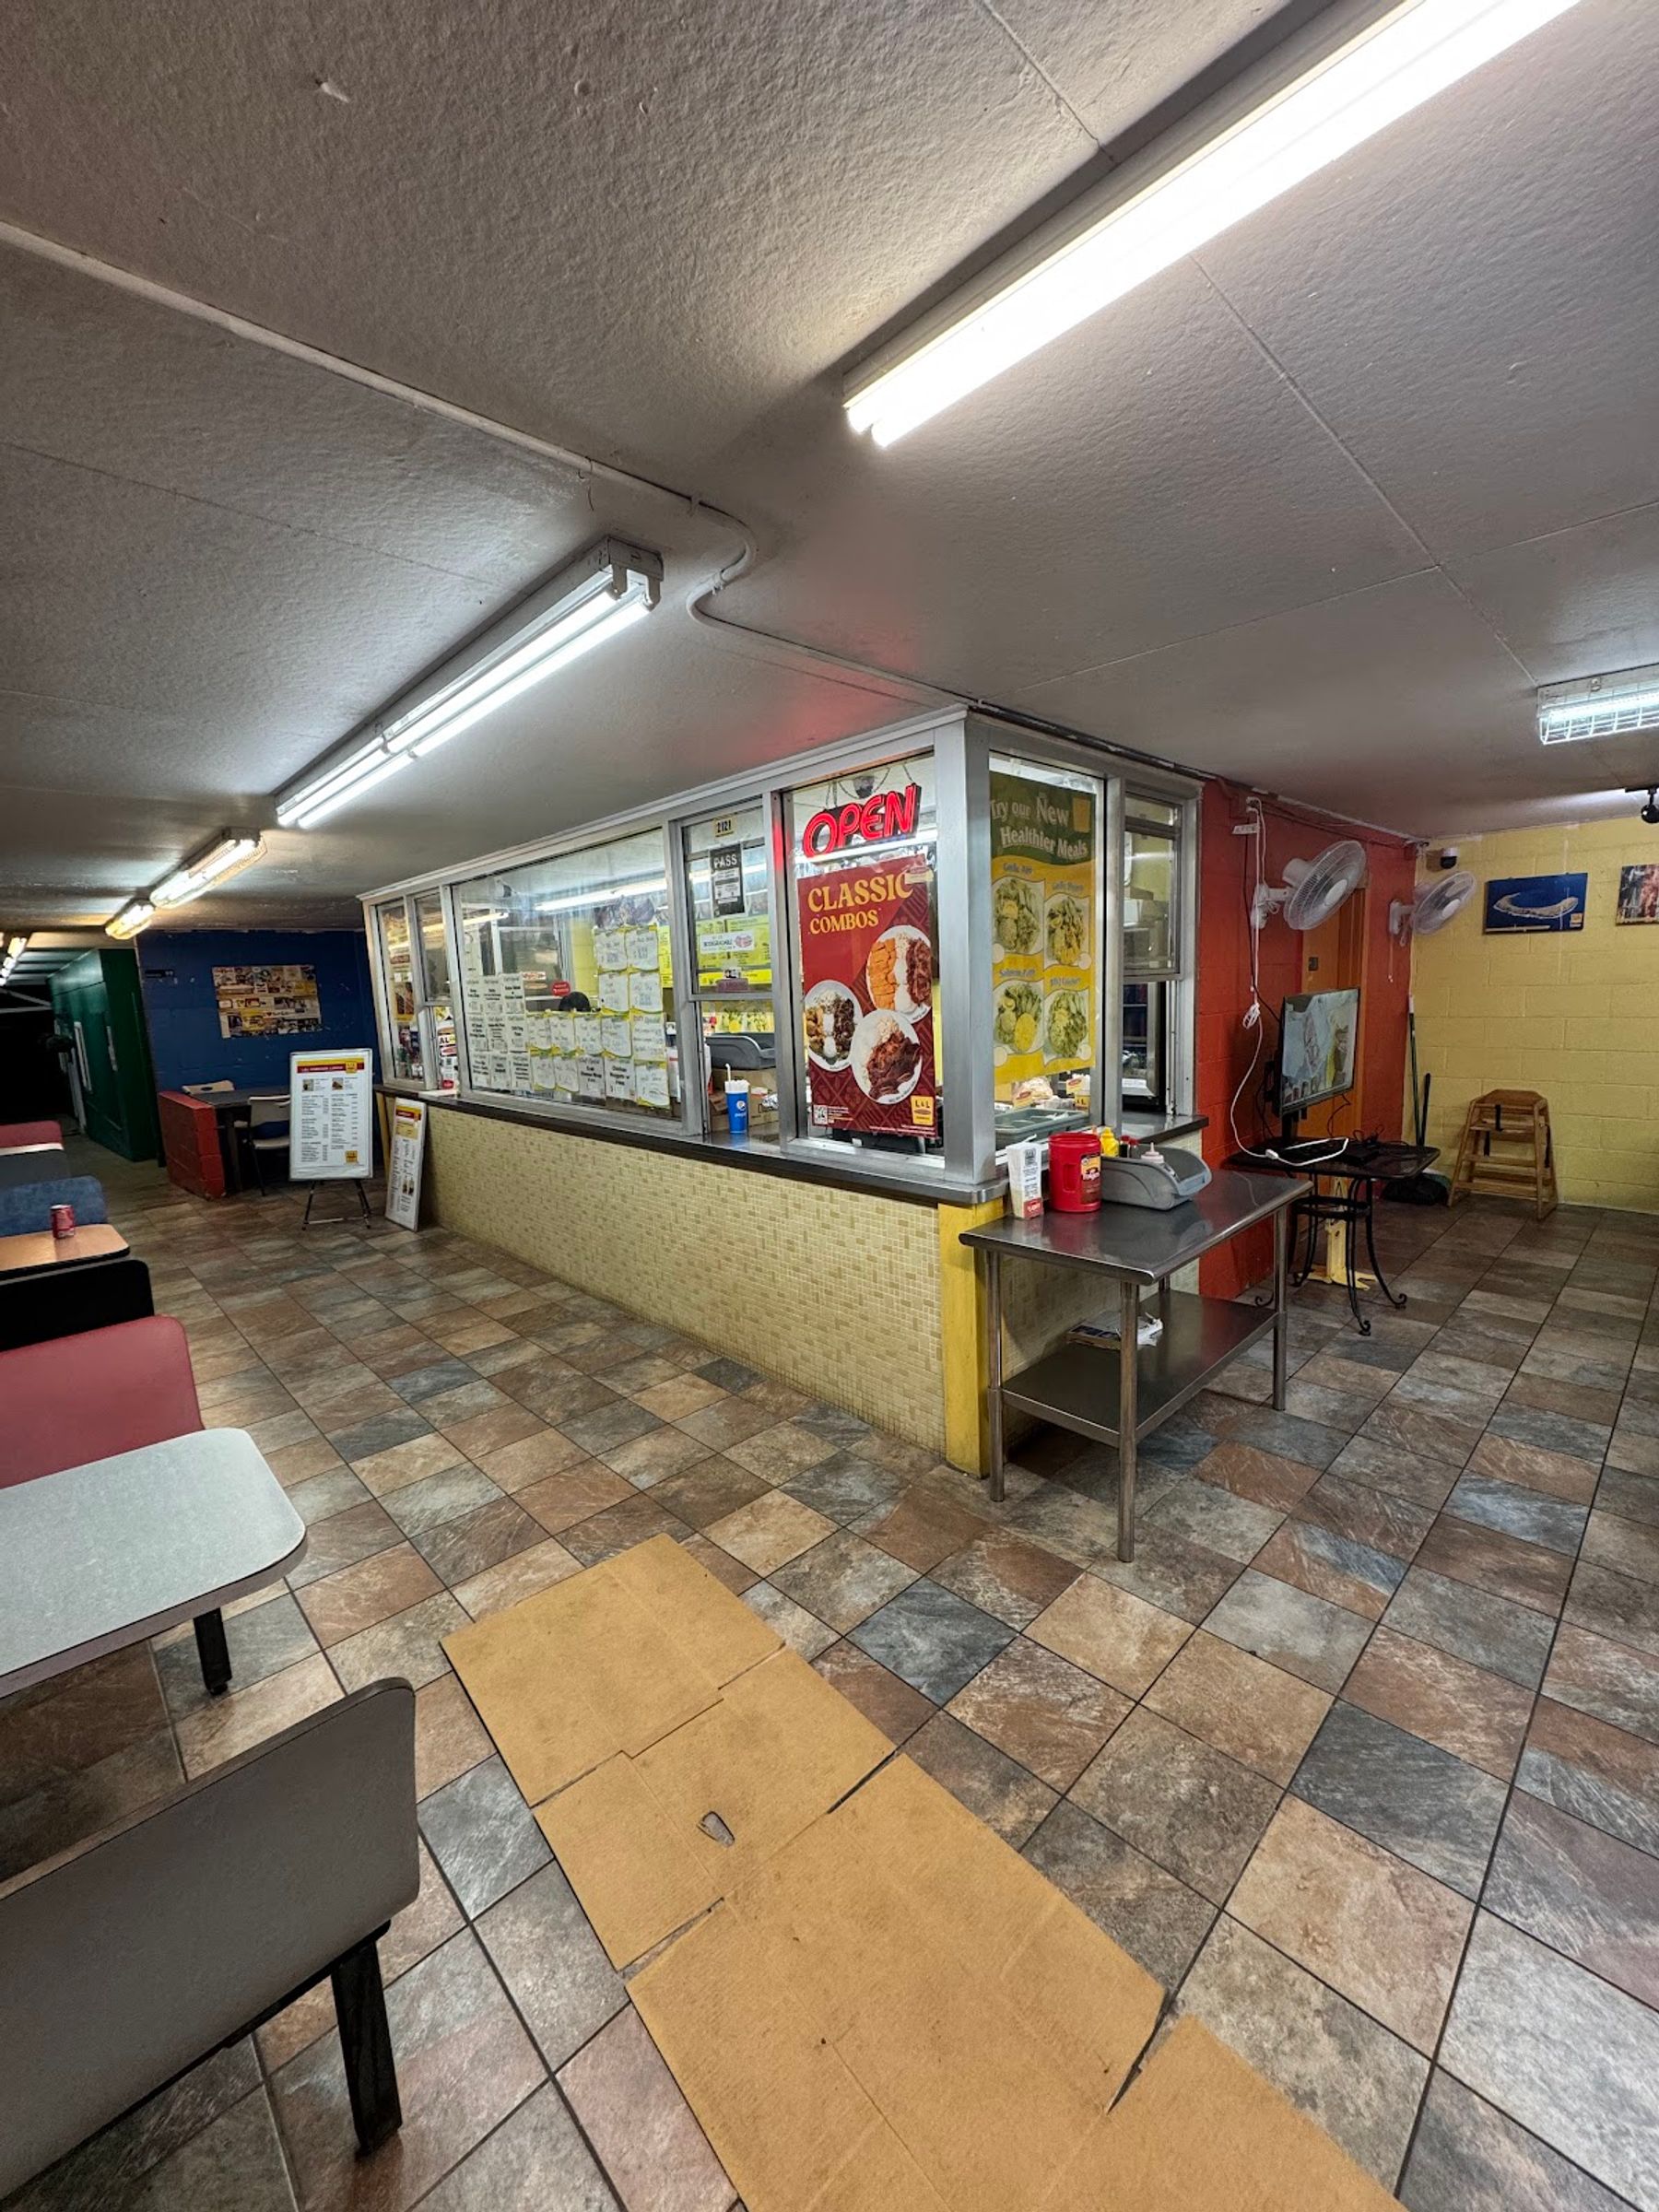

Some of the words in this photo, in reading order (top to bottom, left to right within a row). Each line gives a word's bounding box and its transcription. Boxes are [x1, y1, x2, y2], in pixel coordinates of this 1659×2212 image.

[803, 784, 916, 858] OPEN
[991, 799, 1008, 822] Try
[1011, 801, 1030, 819] our
[1036, 795, 1069, 828] New
[1000, 826, 1055, 854] Healthier
[1056, 837, 1088, 860] Meals
[713, 853, 738, 869] PASS
[807, 873, 913, 912] CLASSIC
[809, 909, 879, 935] COMBOS
